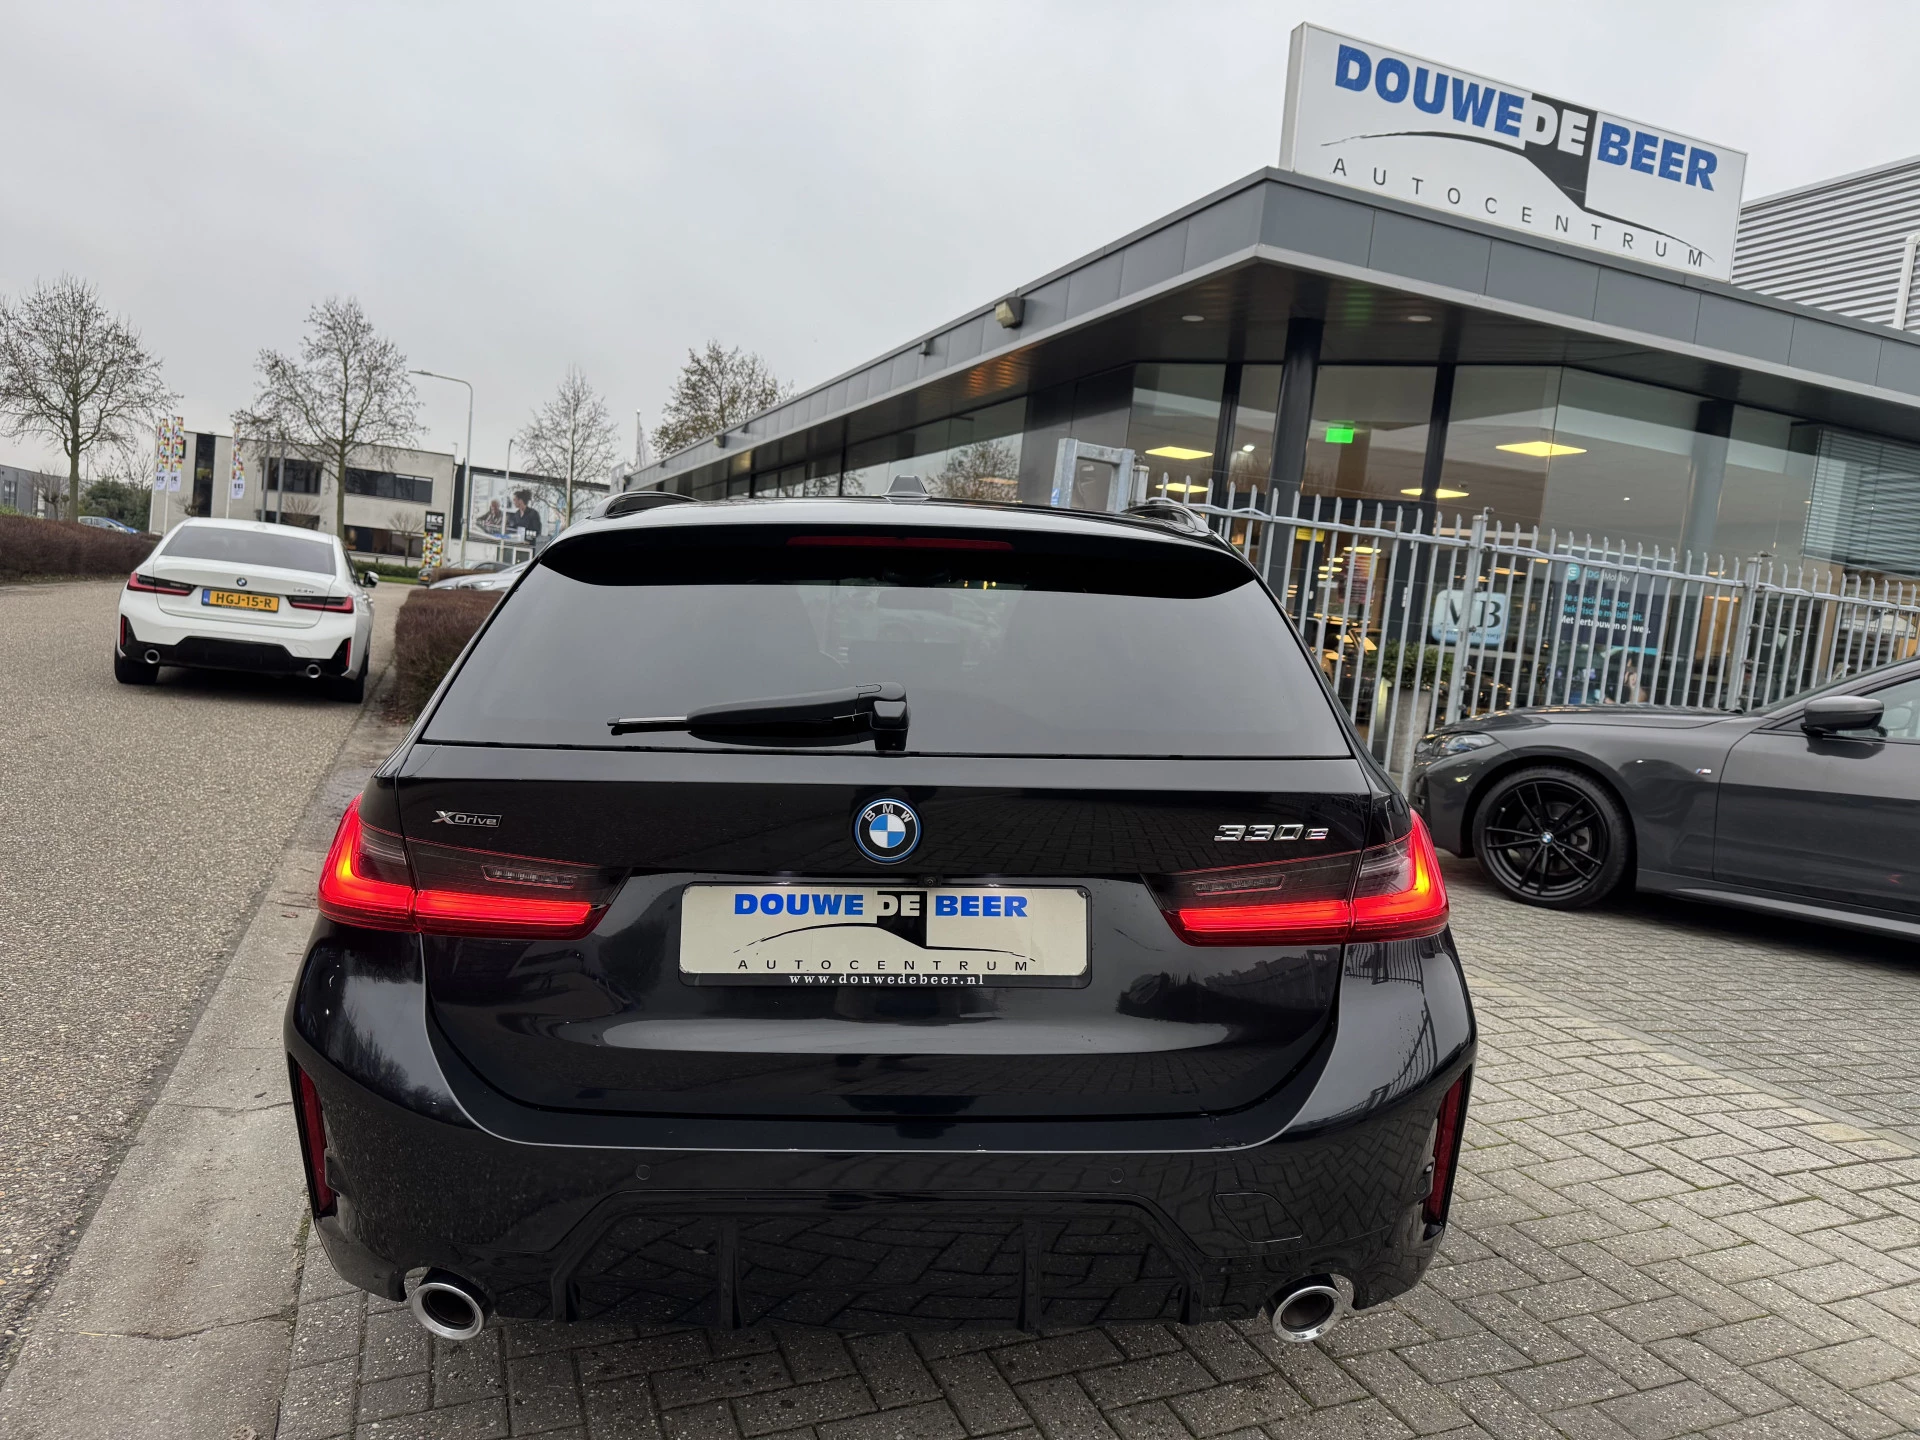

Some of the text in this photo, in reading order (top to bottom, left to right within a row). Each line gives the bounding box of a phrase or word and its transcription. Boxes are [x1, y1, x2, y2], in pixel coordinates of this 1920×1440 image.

[1335, 43, 1718, 192] DOUWE DE BEER
[1332, 157, 1703, 267] AUTOCENTRUM
[216, 592, 272, 608] HGJ-15-R
[864, 803, 913, 823] BMW
[734, 893, 1028, 918] DOUWE DE BEER
[737, 959, 1028, 972] AUTOCENTRUM
[789, 973, 985, 985] www.douwedebeer.nl
